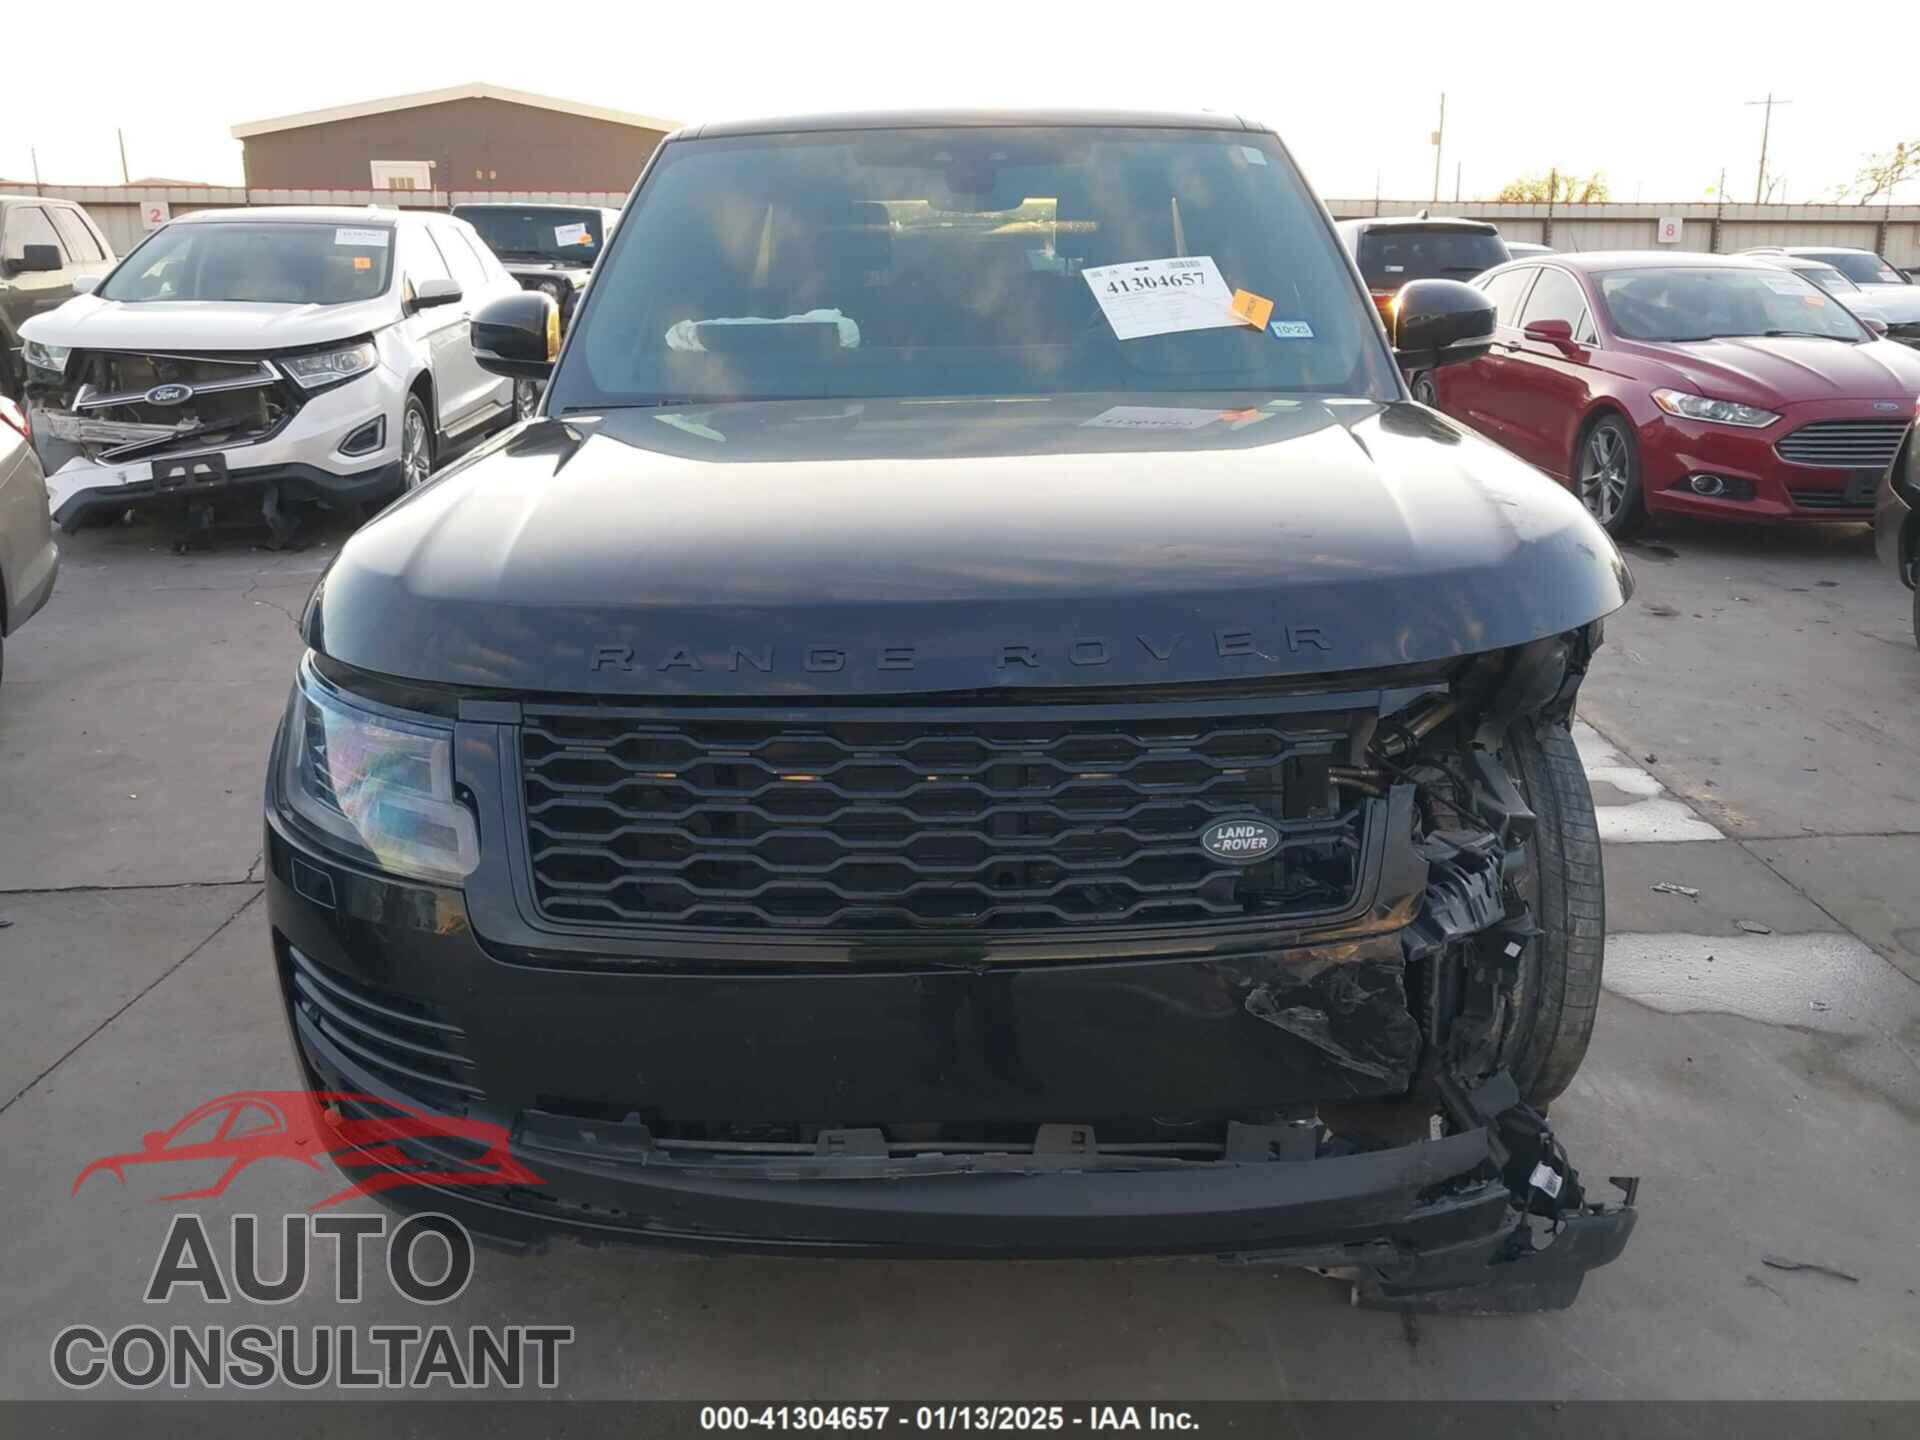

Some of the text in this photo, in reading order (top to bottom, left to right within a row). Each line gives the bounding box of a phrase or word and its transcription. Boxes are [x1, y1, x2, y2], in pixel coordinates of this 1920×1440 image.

[150, 208, 161, 222] 2
[1665, 223, 1675, 237] 8
[1106, 272, 1206, 294] 41304657
[591, 623, 1333, 673] RANGE ROVER
